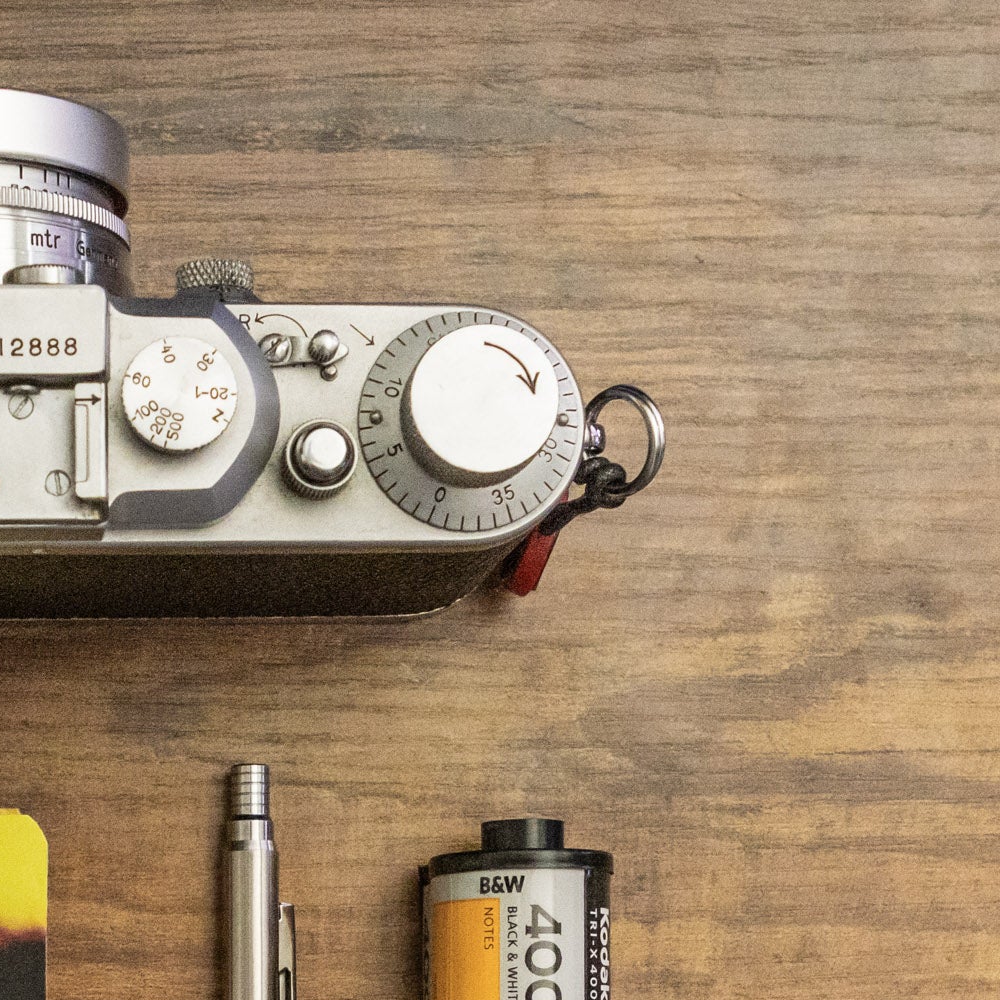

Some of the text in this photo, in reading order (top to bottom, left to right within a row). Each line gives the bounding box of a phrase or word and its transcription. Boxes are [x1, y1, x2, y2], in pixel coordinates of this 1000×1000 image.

[31, 229, 61, 249] mtr
[239, 314, 251, 330] R
[196, 353, 214, 372] 30
[385, 378, 402, 398] 10
[150, 407, 172, 435] 200
[167, 412, 184, 441] 500
[387, 443, 404, 457] 5
[434, 486, 447, 503] 0
[491, 484, 515, 506] 35
[479, 875, 525, 895] B&W
[484, 907, 494, 950] NOTES
[507, 906, 518, 947] BLACK
[589, 908, 598, 959] TRI-X
[507, 953, 518, 962] &
[589, 965, 598, 1000] 400
